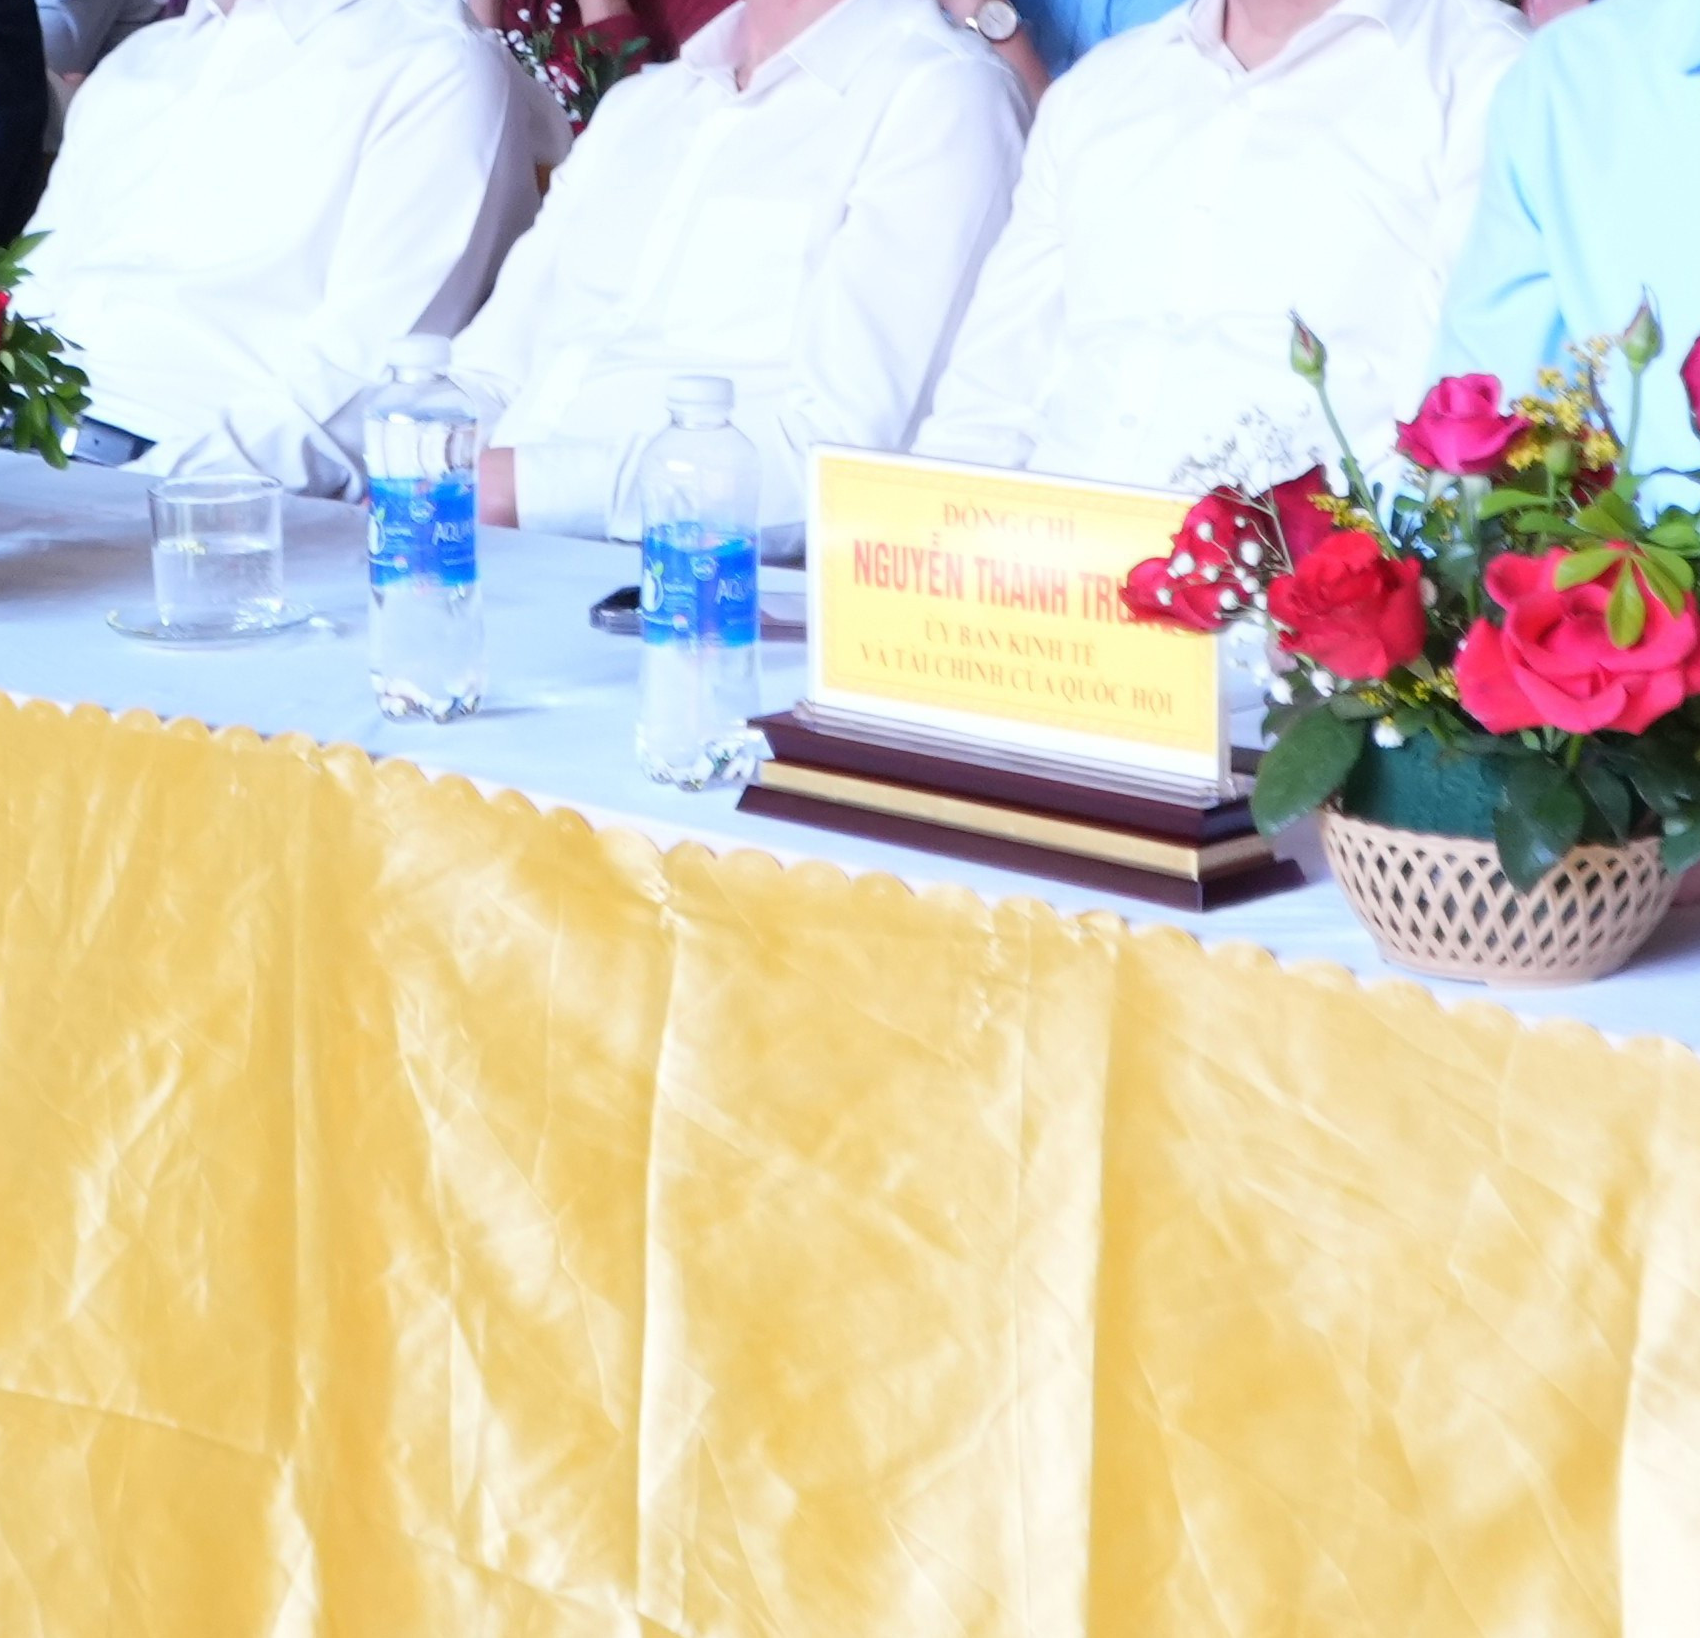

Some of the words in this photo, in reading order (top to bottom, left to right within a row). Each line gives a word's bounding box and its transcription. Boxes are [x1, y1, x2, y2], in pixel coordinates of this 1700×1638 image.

[943, 499, 1022, 537] ĐỒNG
[854, 532, 965, 601] NGUYỄN
[976, 551, 1068, 617] THÀNH
[960, 624, 1001, 652] BAN
[1009, 629, 1063, 661] KINH
[1072, 639, 1096, 667] TẾ
[859, 641, 890, 669] VÀ
[893, 645, 929, 674] TÀI
[935, 653, 1003, 686] CHÍNH
[1011, 662, 1056, 696] CỦA
[1061, 674, 1121, 707] QUỐC
[1132, 687, 1173, 717] HỘI
